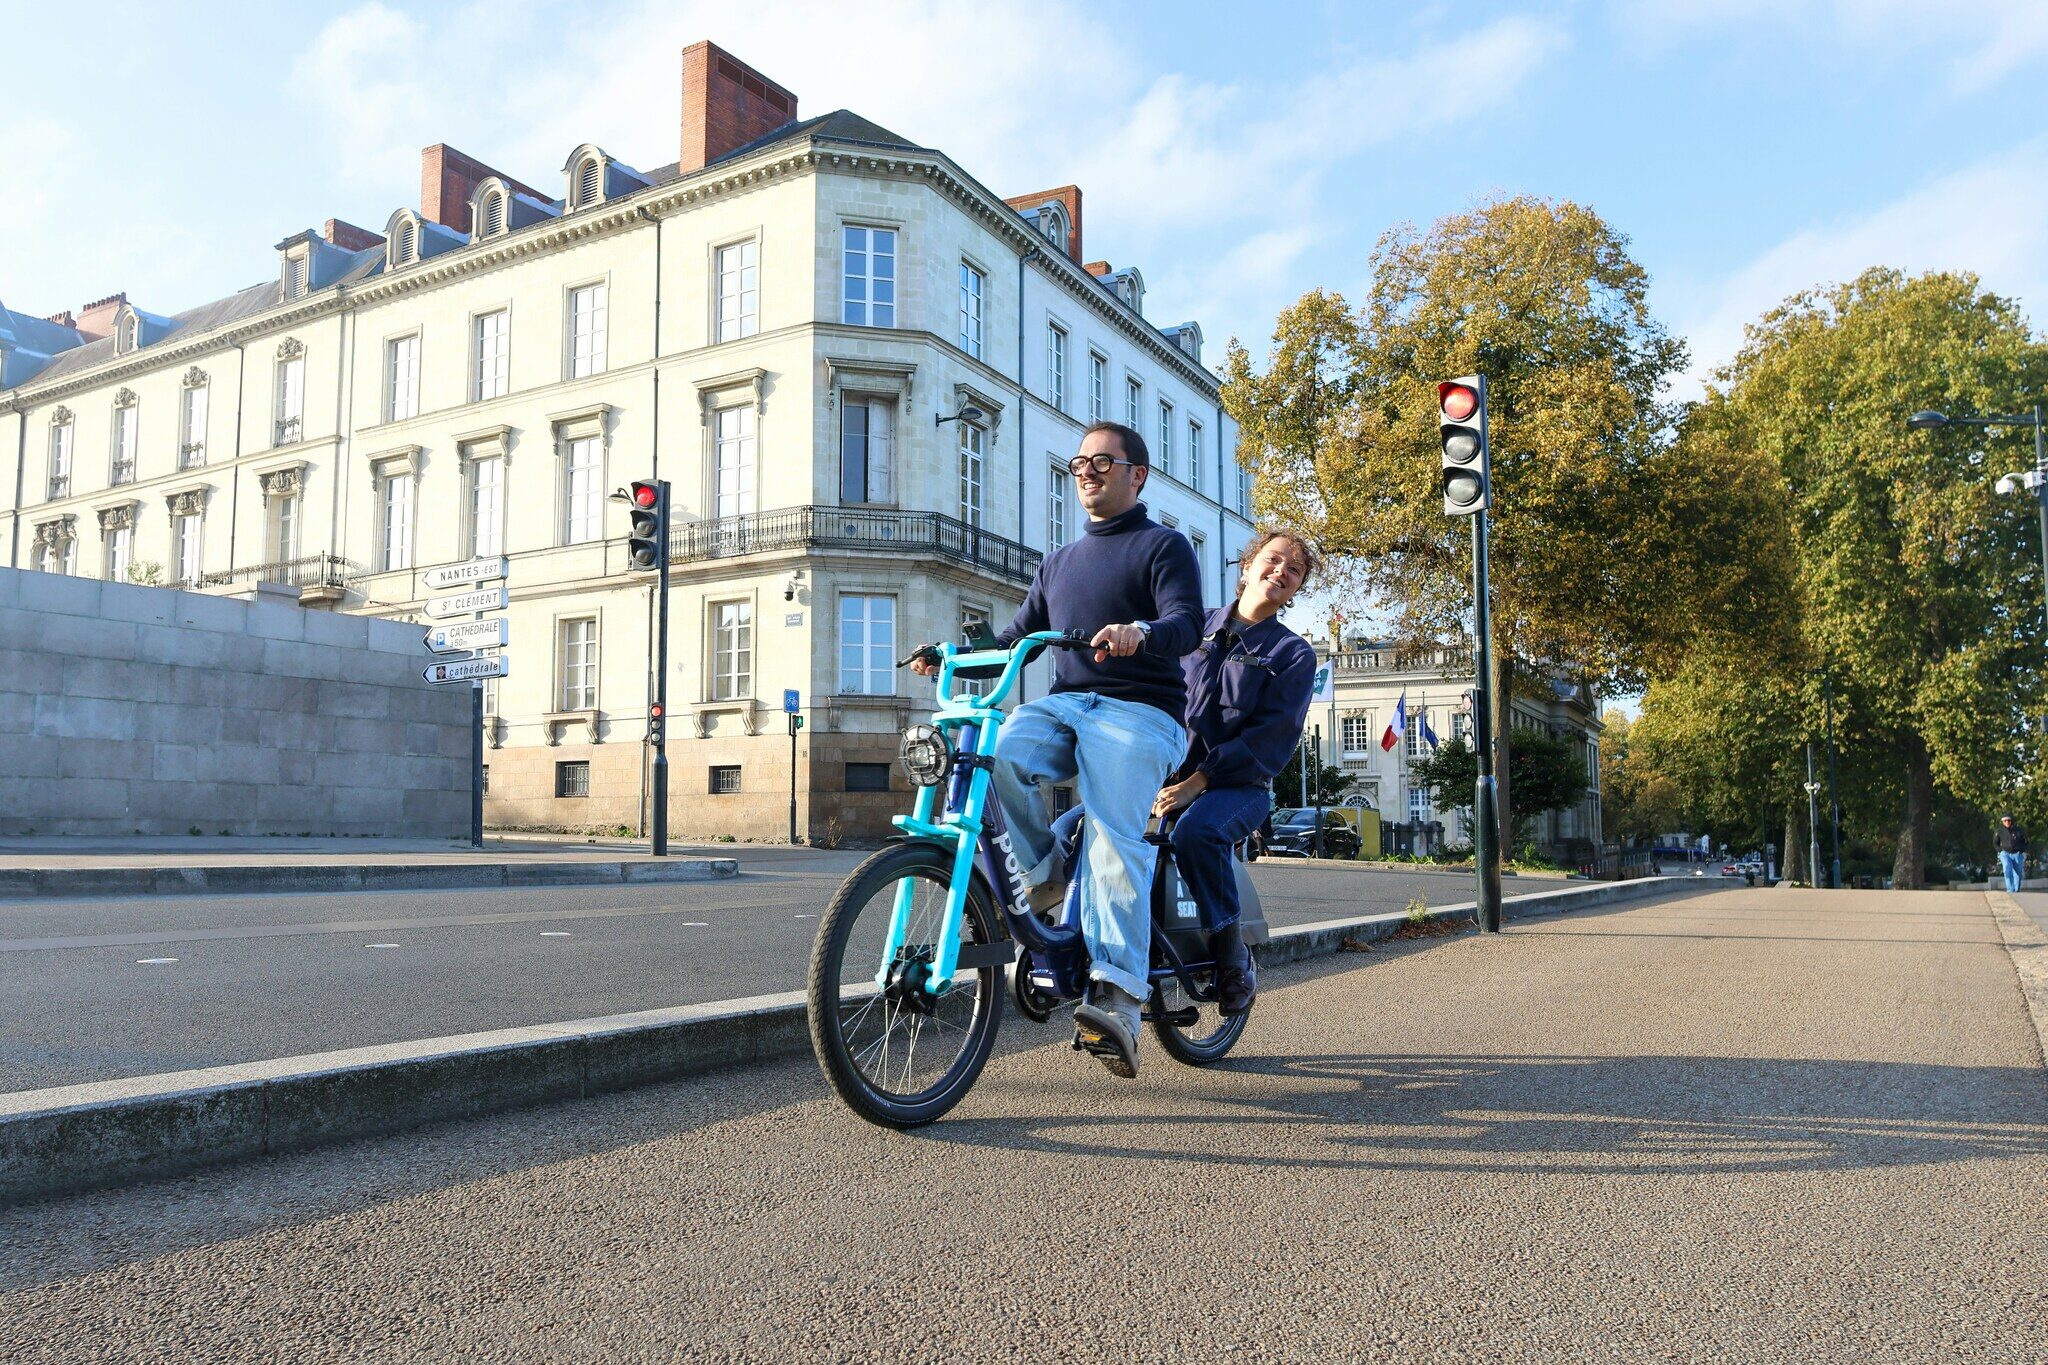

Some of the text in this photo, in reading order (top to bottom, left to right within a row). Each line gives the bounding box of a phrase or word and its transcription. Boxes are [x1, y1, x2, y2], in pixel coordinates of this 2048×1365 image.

[440, 566, 479, 581] NANTES
[455, 593, 498, 609] CLÉMENT
[450, 622, 498, 638] CATHÉDRALE
[449, 662, 498, 676] cathédrale
[992, 831, 1031, 915] pony
[1177, 881, 1184, 898] A
[1177, 901, 1197, 917] SEAT
